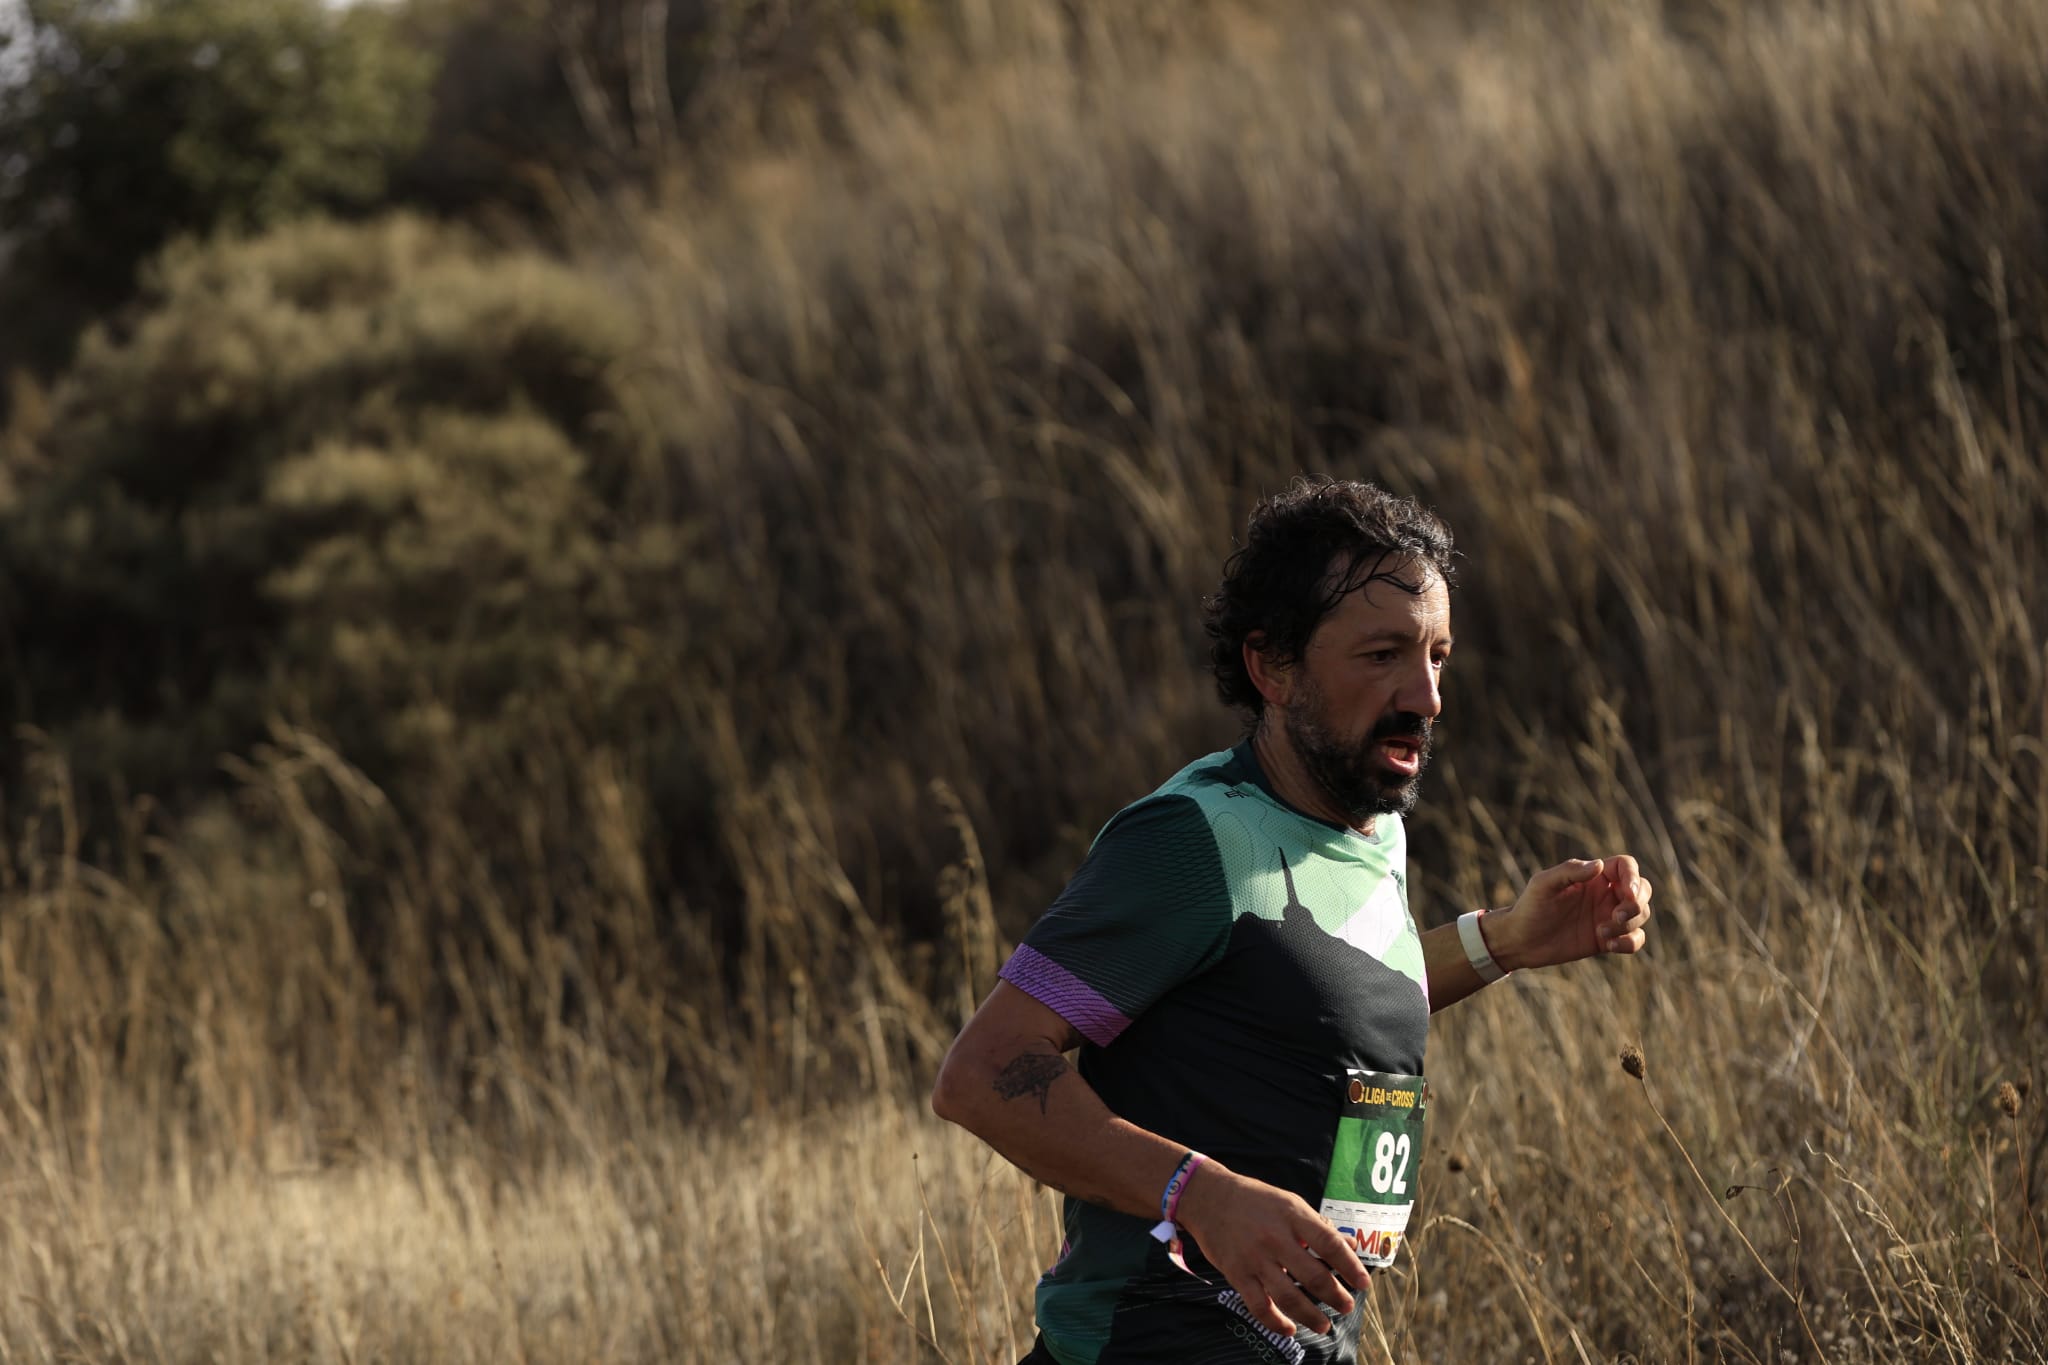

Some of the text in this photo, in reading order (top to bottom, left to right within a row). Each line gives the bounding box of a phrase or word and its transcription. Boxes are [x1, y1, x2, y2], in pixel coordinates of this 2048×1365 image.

[1365, 1086, 1385, 1105] LIGA
[1391, 1089, 1415, 1108] CROSS
[1371, 1131, 1411, 1195] 82
